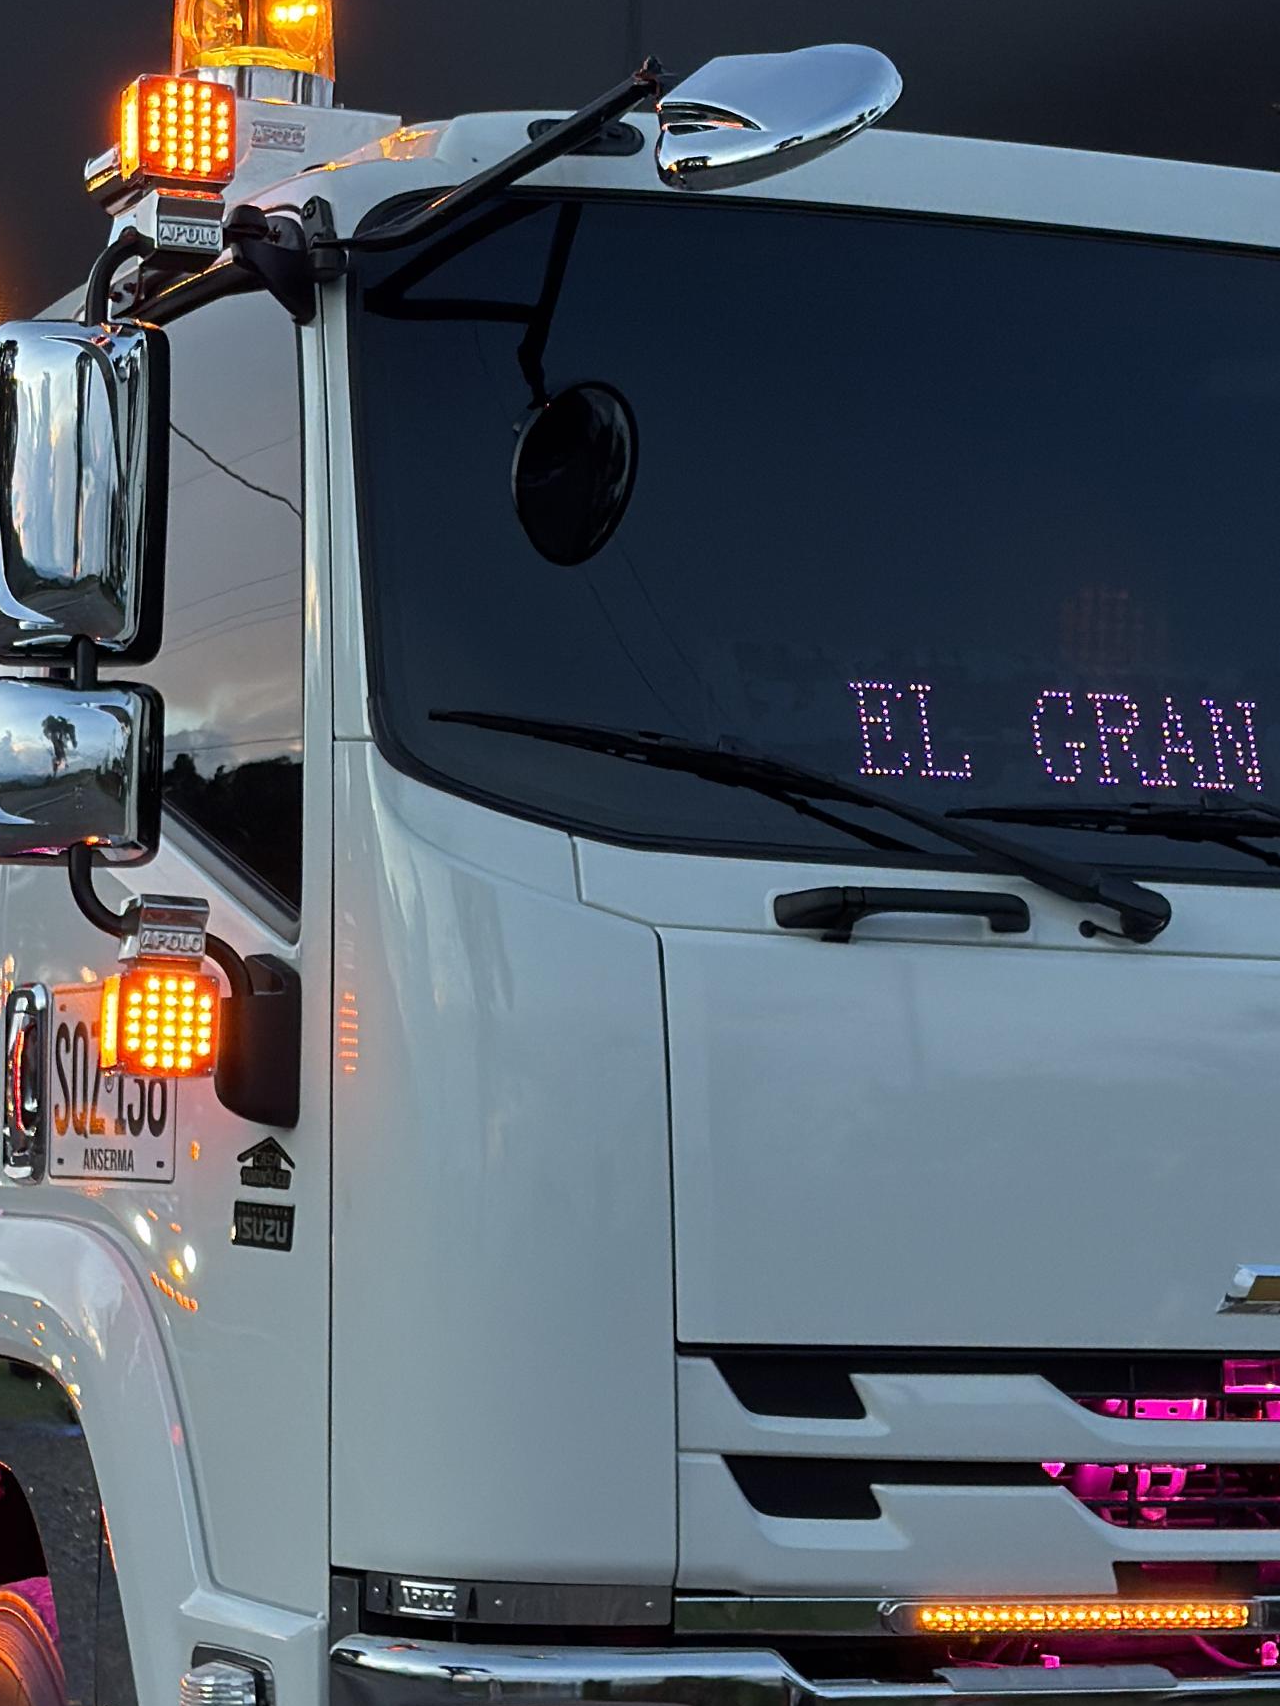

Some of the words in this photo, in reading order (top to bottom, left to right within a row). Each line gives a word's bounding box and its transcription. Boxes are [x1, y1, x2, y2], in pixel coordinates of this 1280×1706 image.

[160, 223, 220, 246] APOLO
[848, 680, 972, 781] EL
[1030, 690, 1264, 793] GRAN
[83, 1149, 135, 1173] ANSERMA
[237, 1217, 289, 1244] ISUZU
